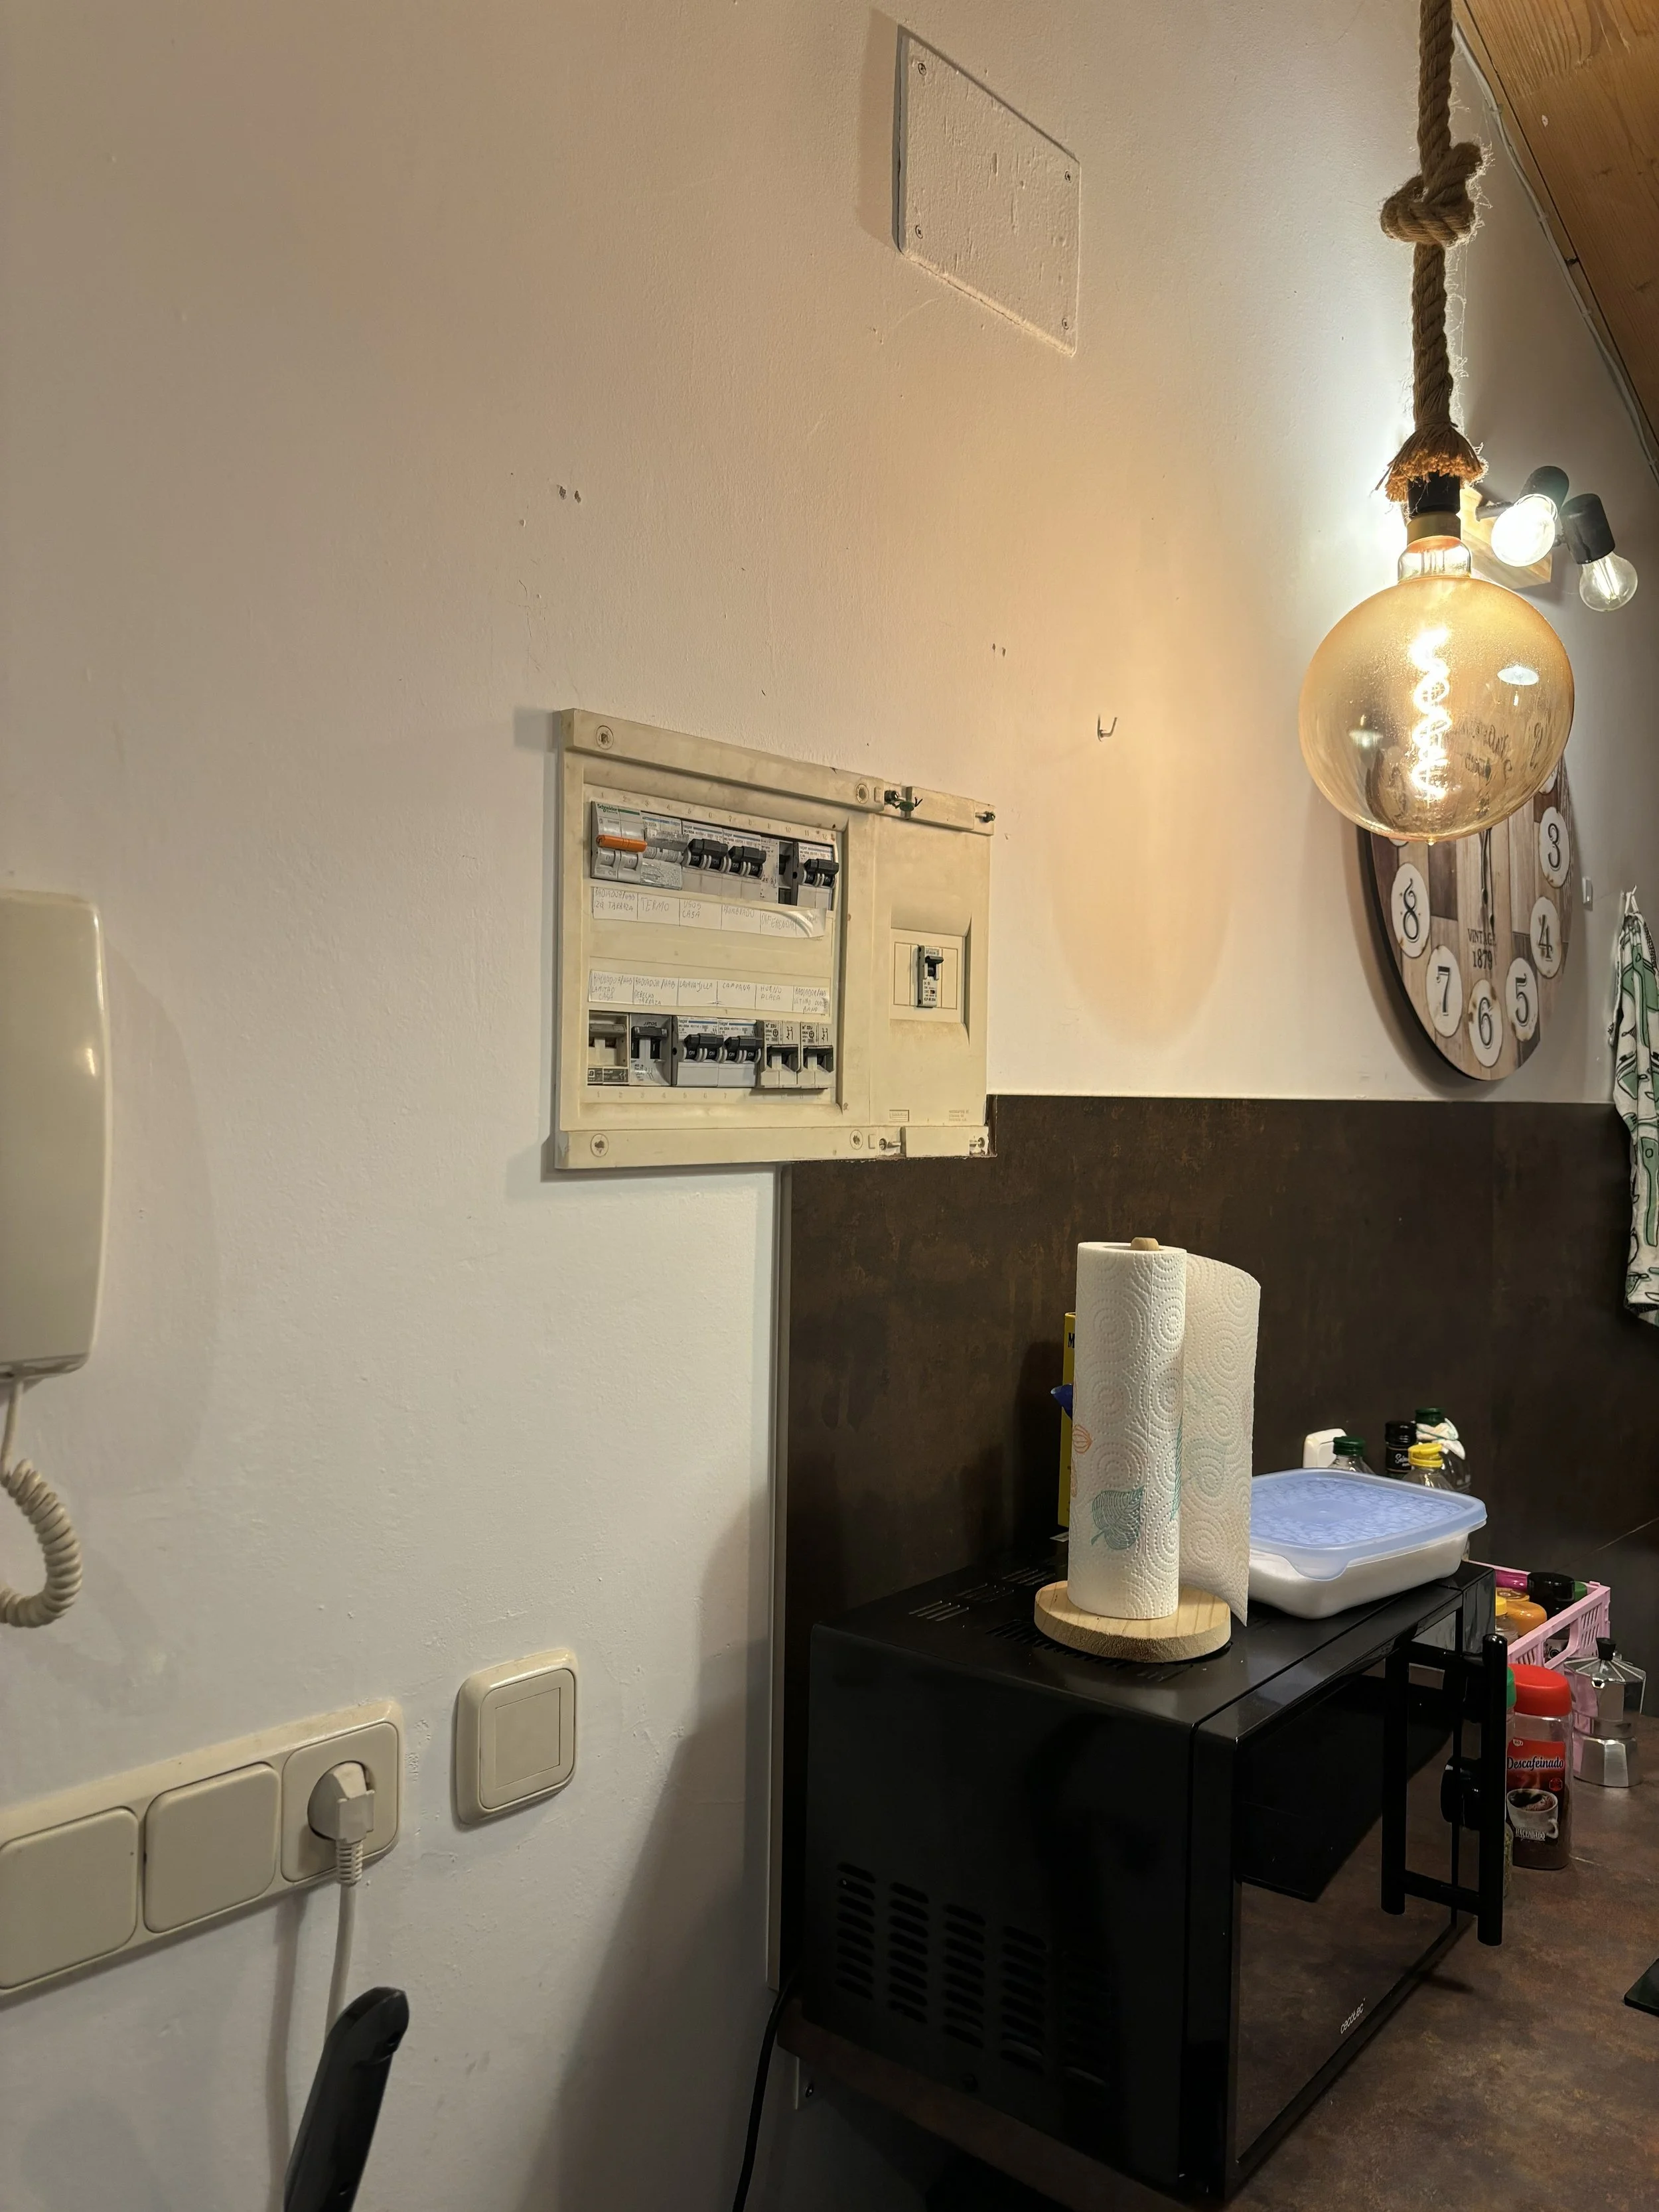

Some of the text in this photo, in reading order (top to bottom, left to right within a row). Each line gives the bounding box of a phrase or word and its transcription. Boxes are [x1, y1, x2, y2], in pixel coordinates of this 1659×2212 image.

[1548, 823, 1560, 871] 3
[641, 897, 670, 912] TERMO
[1402, 878, 1420, 942] 8
[1473, 948, 1493, 971] 1879
[1538, 914, 1553, 962] 4
[1436, 965, 1451, 1017] 7
[1514, 974, 1530, 1027] 5
[1477, 996, 1493, 1049] 6
[1068, 1332, 1075, 1348] M
[1507, 1756, 1564, 1771] Descafeinado
